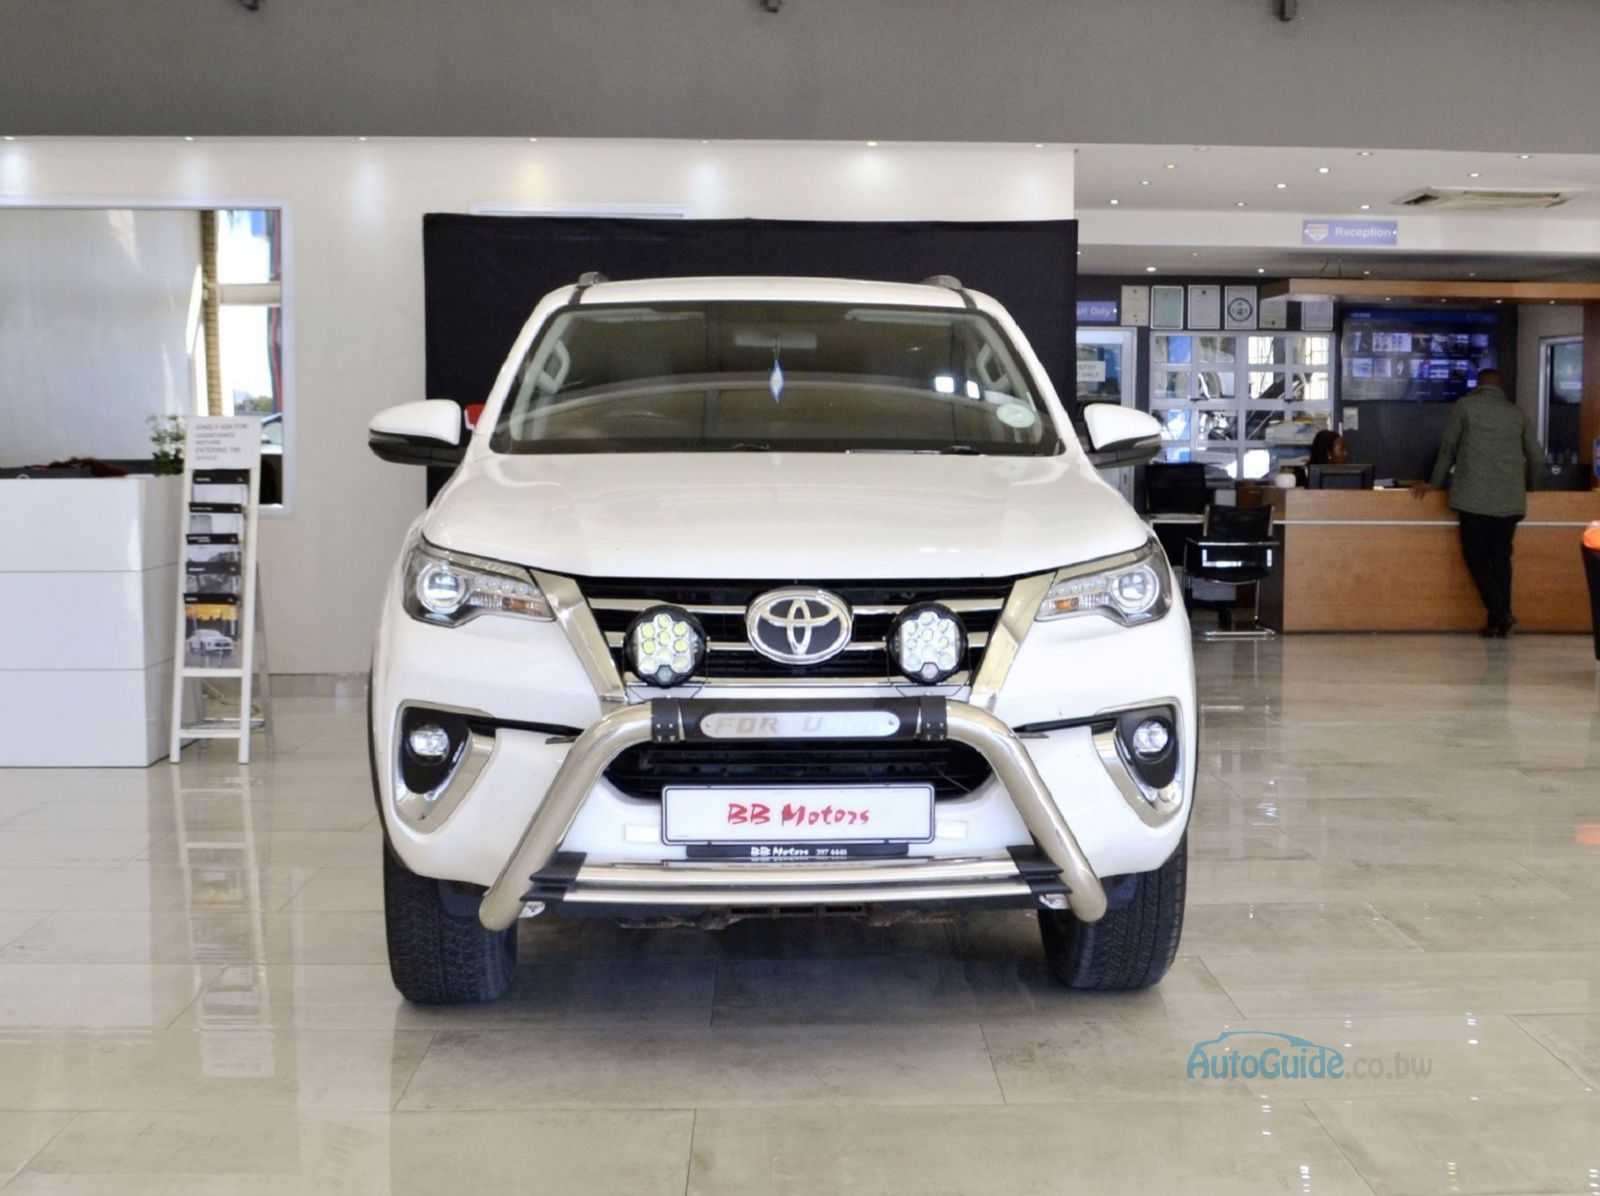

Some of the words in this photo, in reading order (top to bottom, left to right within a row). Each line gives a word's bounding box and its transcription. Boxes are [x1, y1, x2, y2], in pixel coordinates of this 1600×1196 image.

[1335, 226, 1391, 239] Reception
[728, 803, 771, 825] BB
[782, 803, 870, 826] Motors
[750, 846, 771, 857] BB
[772, 846, 809, 856] Motors
